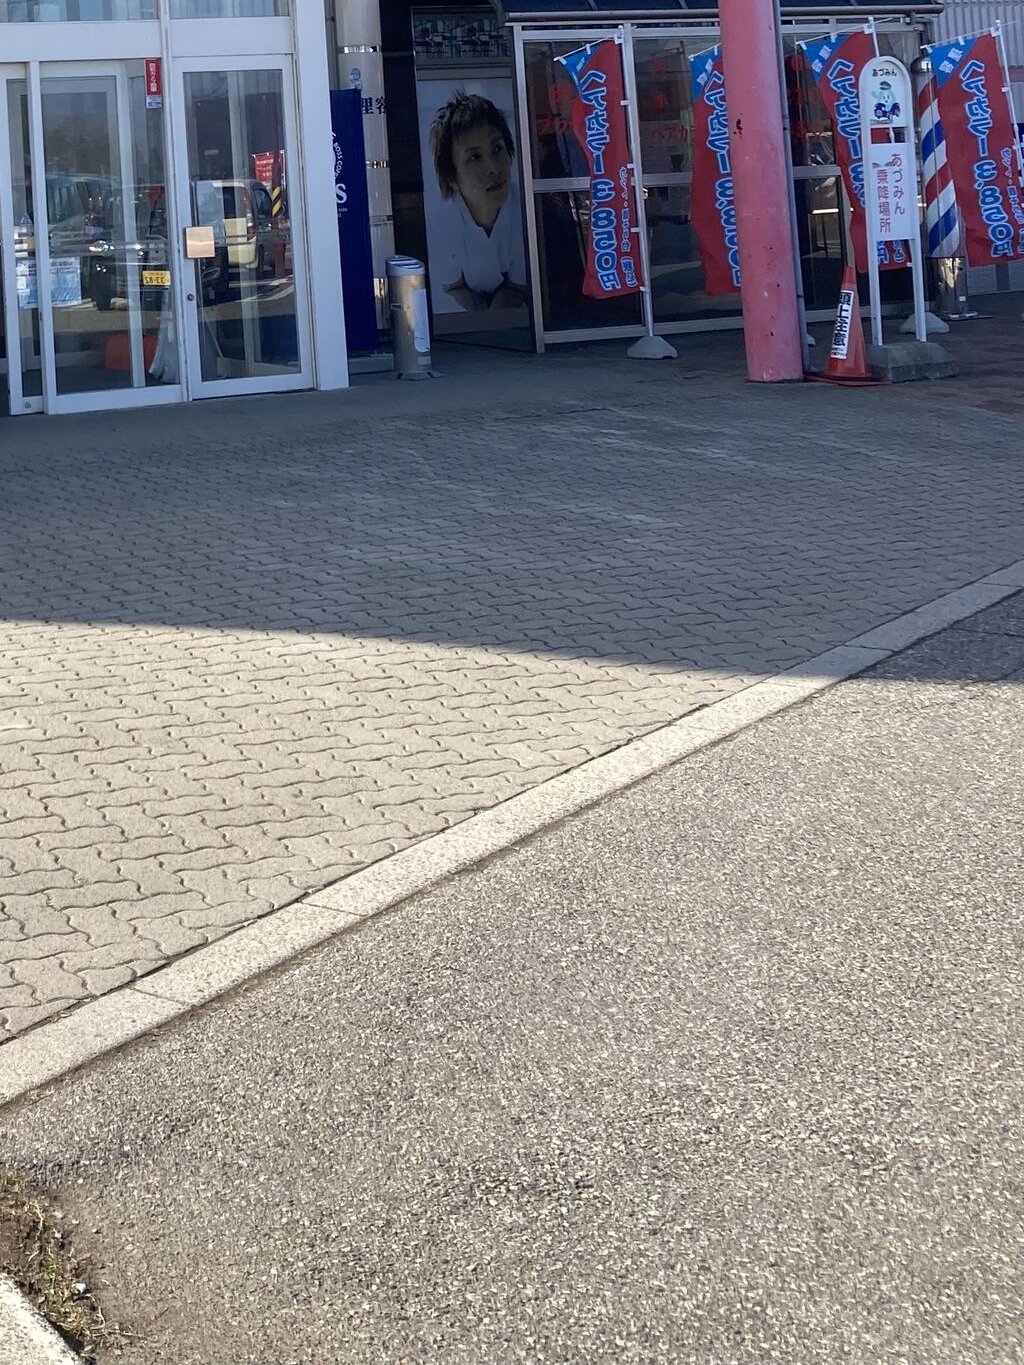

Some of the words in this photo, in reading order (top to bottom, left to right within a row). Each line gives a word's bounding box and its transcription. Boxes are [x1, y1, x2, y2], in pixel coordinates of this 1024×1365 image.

[871, 68, 898, 78] あづみん
[876, 169, 891, 234] 乗降場所
[891, 152, 906, 216] あづみん
